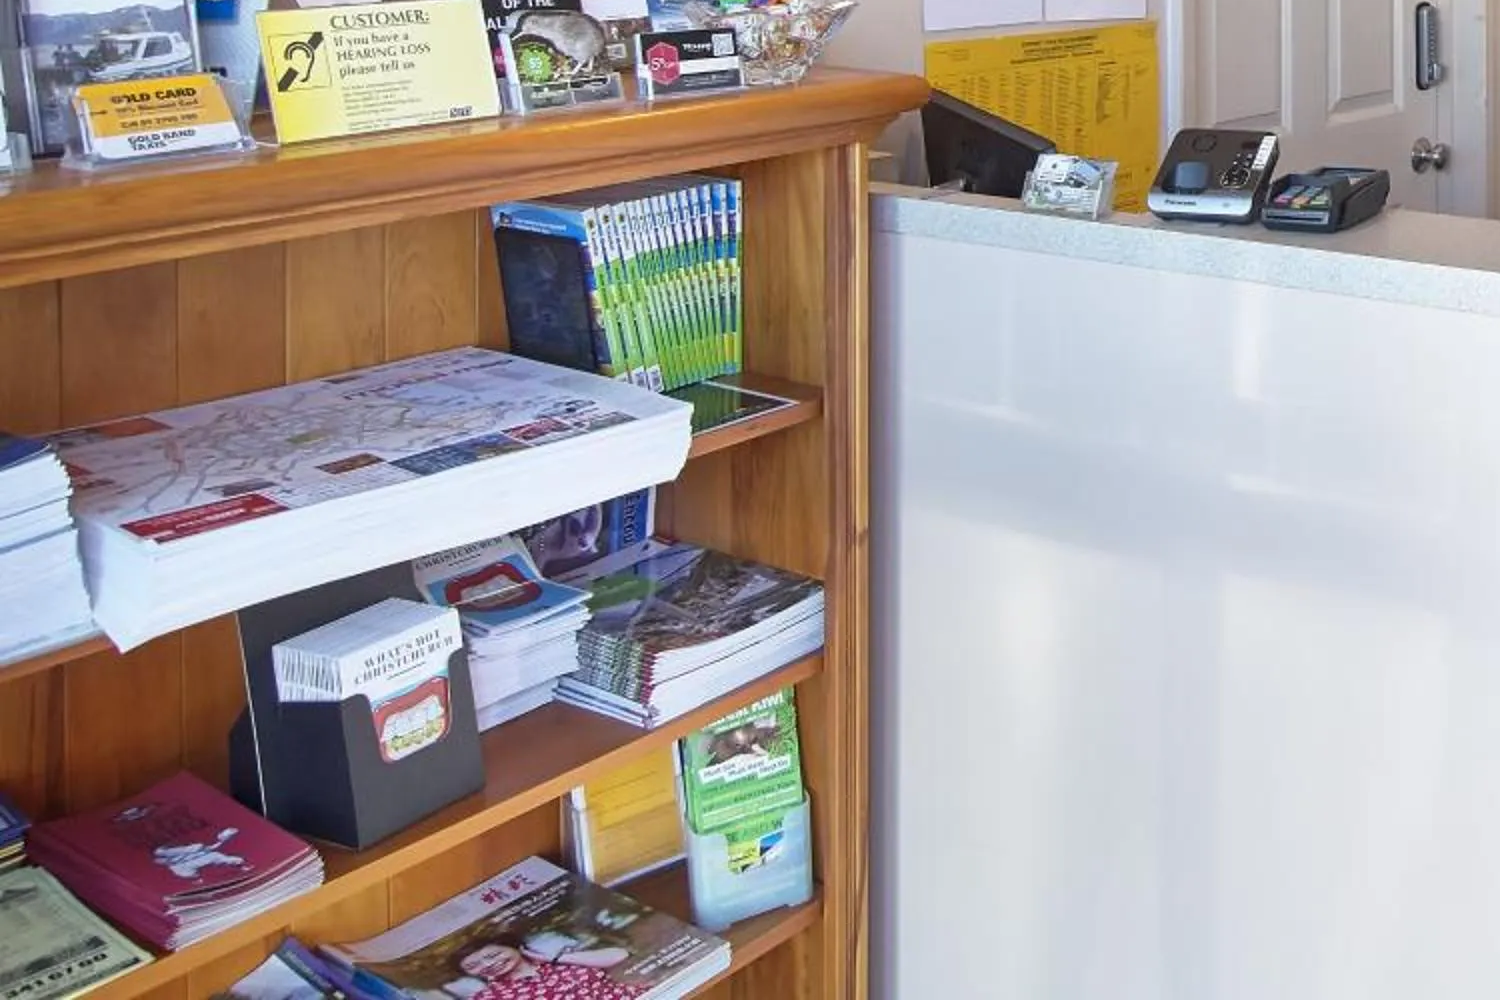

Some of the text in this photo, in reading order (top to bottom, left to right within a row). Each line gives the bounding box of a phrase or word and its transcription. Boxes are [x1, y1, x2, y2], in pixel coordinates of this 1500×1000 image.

[330, 10, 430, 28] CUSTOMER:
[334, 36, 344, 46] If
[347, 36, 369, 47] you
[371, 33, 399, 44] have
[337, 44, 431, 62] HEARING LOSS
[339, 61, 415, 78] please tell us
[110, 87, 197, 104] GOLD CARD
[364, 629, 441, 668] WHAT'S HOT
[354, 635, 453, 685] CHRISTCHURCH
